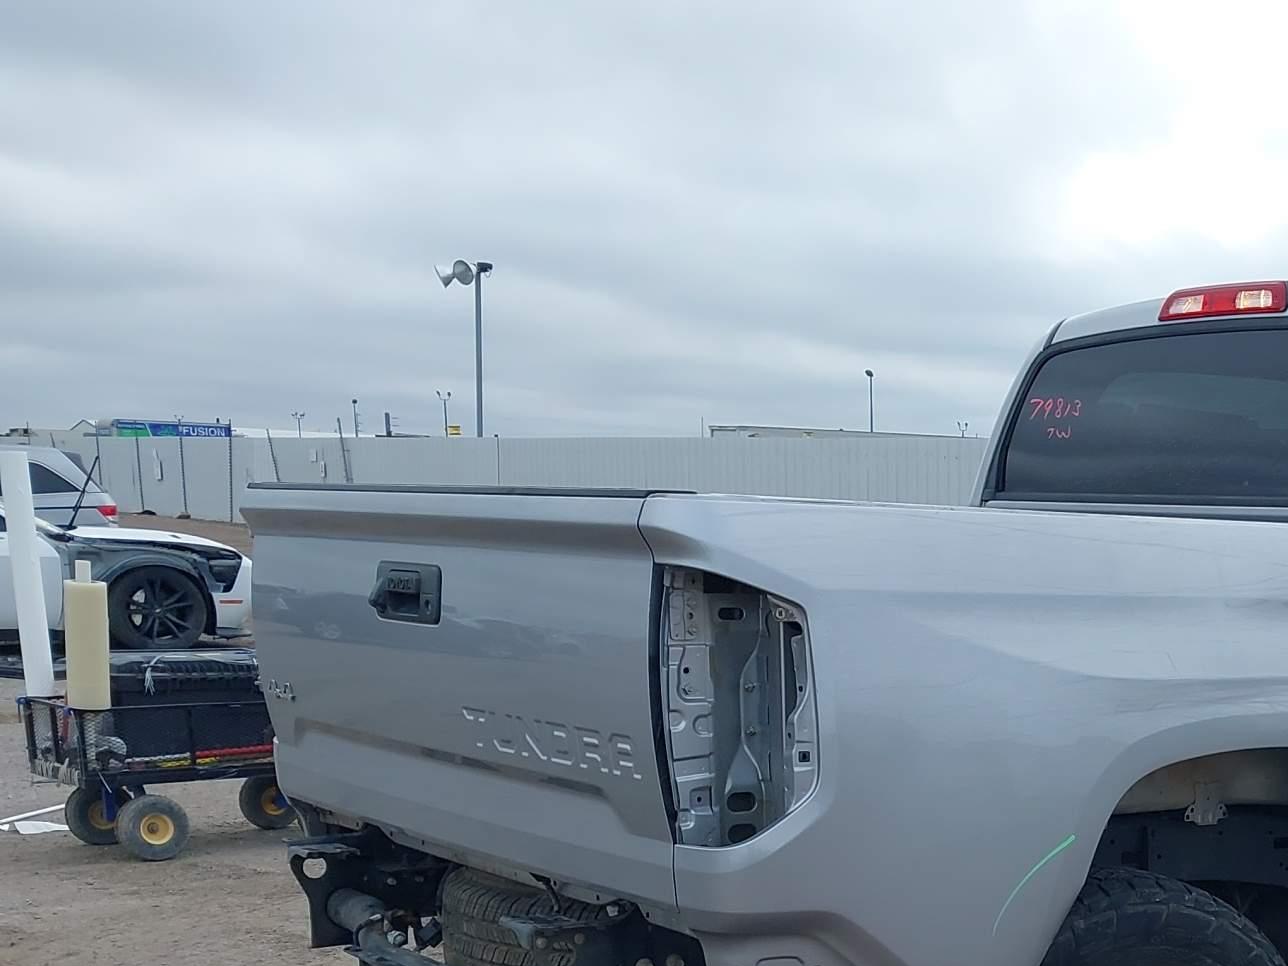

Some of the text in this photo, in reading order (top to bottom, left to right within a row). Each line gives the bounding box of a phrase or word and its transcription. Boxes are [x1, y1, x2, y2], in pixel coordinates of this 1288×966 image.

[1029, 397, 1082, 420] 79813
[182, 425, 226, 437] FUSION
[461, 705, 643, 779] TUNDRA
